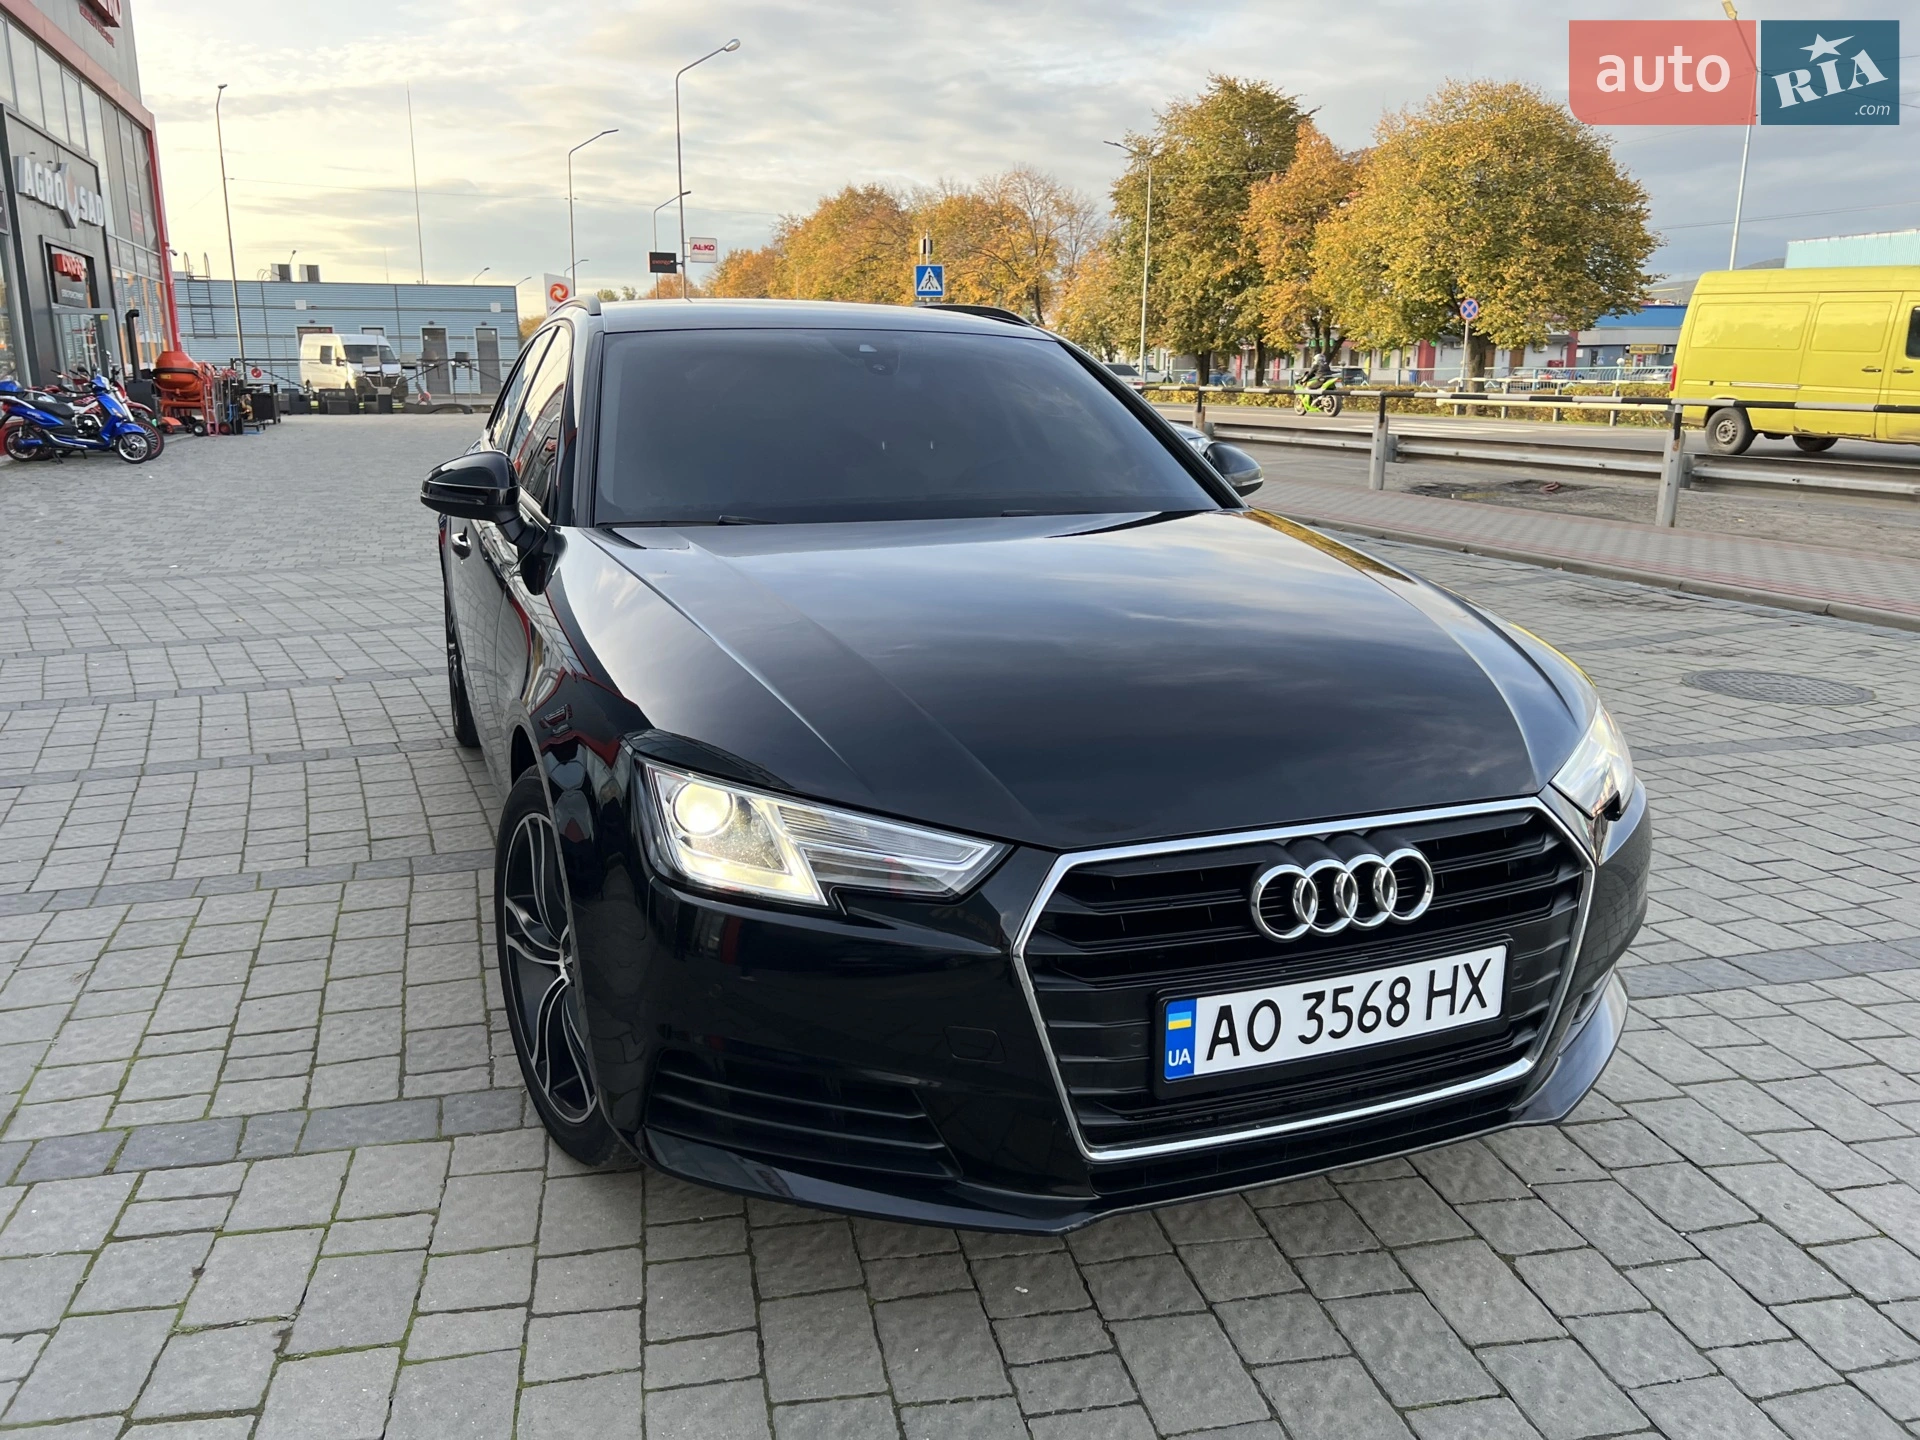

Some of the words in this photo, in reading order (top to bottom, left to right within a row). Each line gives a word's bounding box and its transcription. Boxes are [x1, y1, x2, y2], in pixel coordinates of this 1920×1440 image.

[20, 156, 65, 210] AGRO
[79, 186, 105, 227] SAD
[1206, 999, 1281, 1061] AO
[1298, 975, 1411, 1045] 3568
[1425, 958, 1492, 1021] HX
[1168, 1048, 1191, 1067] UA
